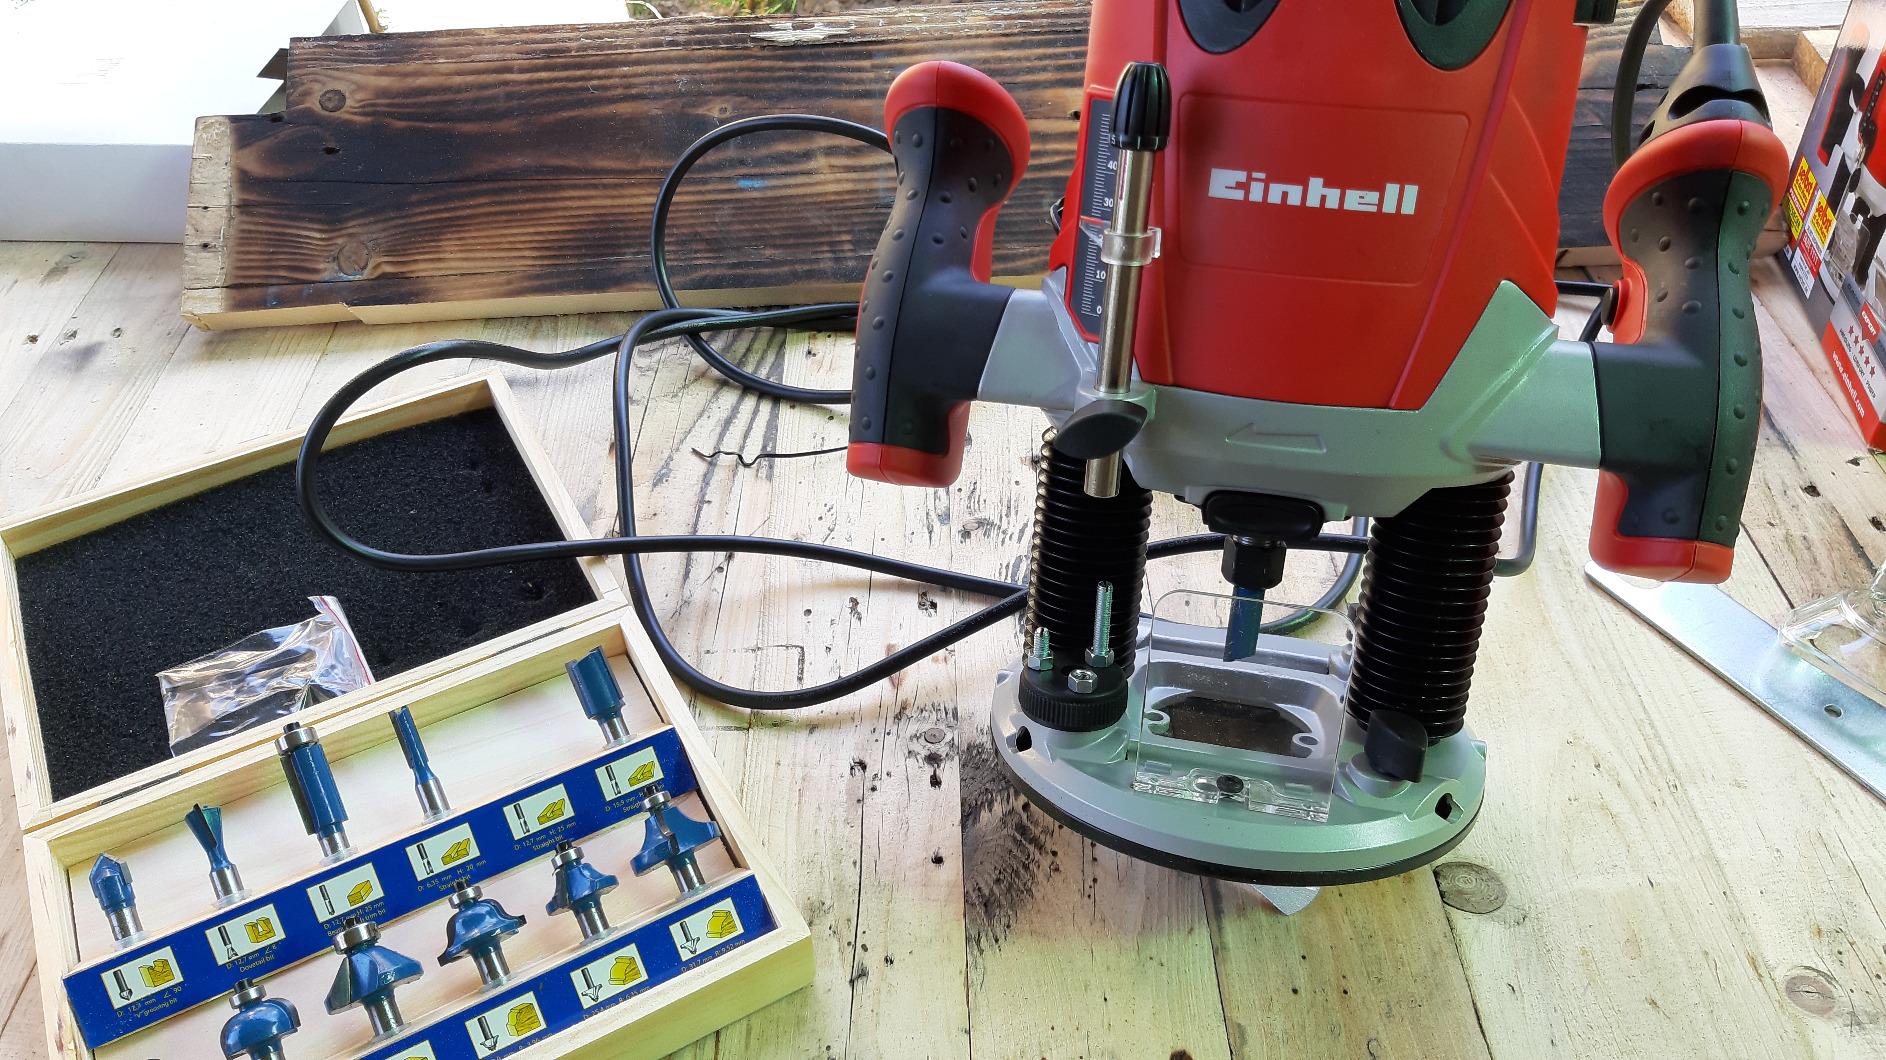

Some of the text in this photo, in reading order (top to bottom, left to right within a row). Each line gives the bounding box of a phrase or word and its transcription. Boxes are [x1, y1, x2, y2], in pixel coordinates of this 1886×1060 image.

[1107, 160, 1118, 171] 40
[1208, 168, 1419, 215] Einhell
[1103, 198, 1114, 208] 30
[1096, 270, 1106, 280] 10
[1096, 305, 1102, 315] 0
[240, 957, 266, 972] Dovetail
